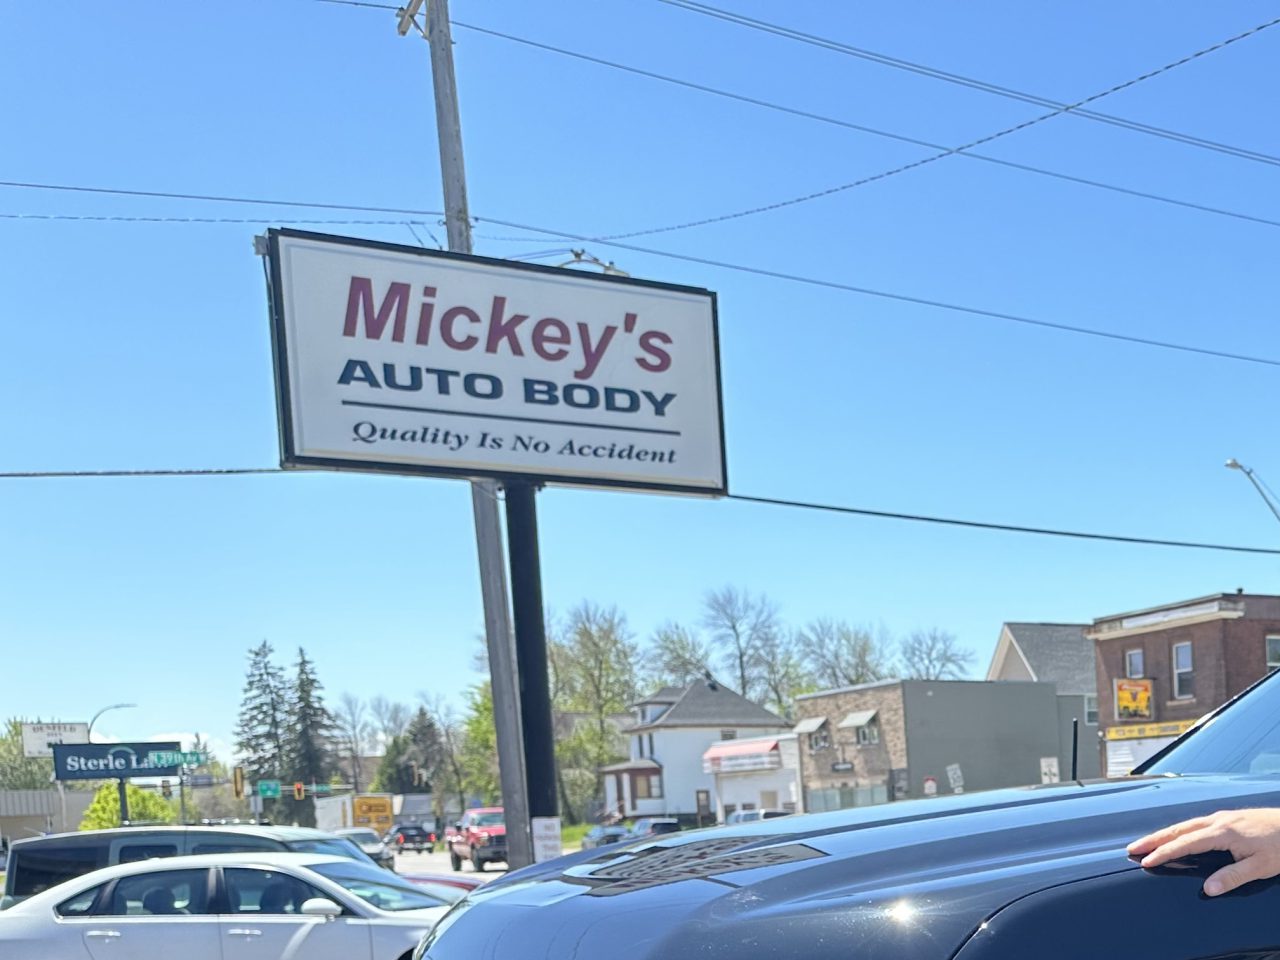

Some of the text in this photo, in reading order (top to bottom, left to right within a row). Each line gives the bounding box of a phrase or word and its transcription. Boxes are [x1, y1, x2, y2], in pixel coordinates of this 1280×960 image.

[342, 276, 673, 380] Mickey's
[337, 359, 678, 417] AUTO BODY
[351, 421, 678, 464] Quality Is No Accident
[66, 754, 126, 771] Sterle
